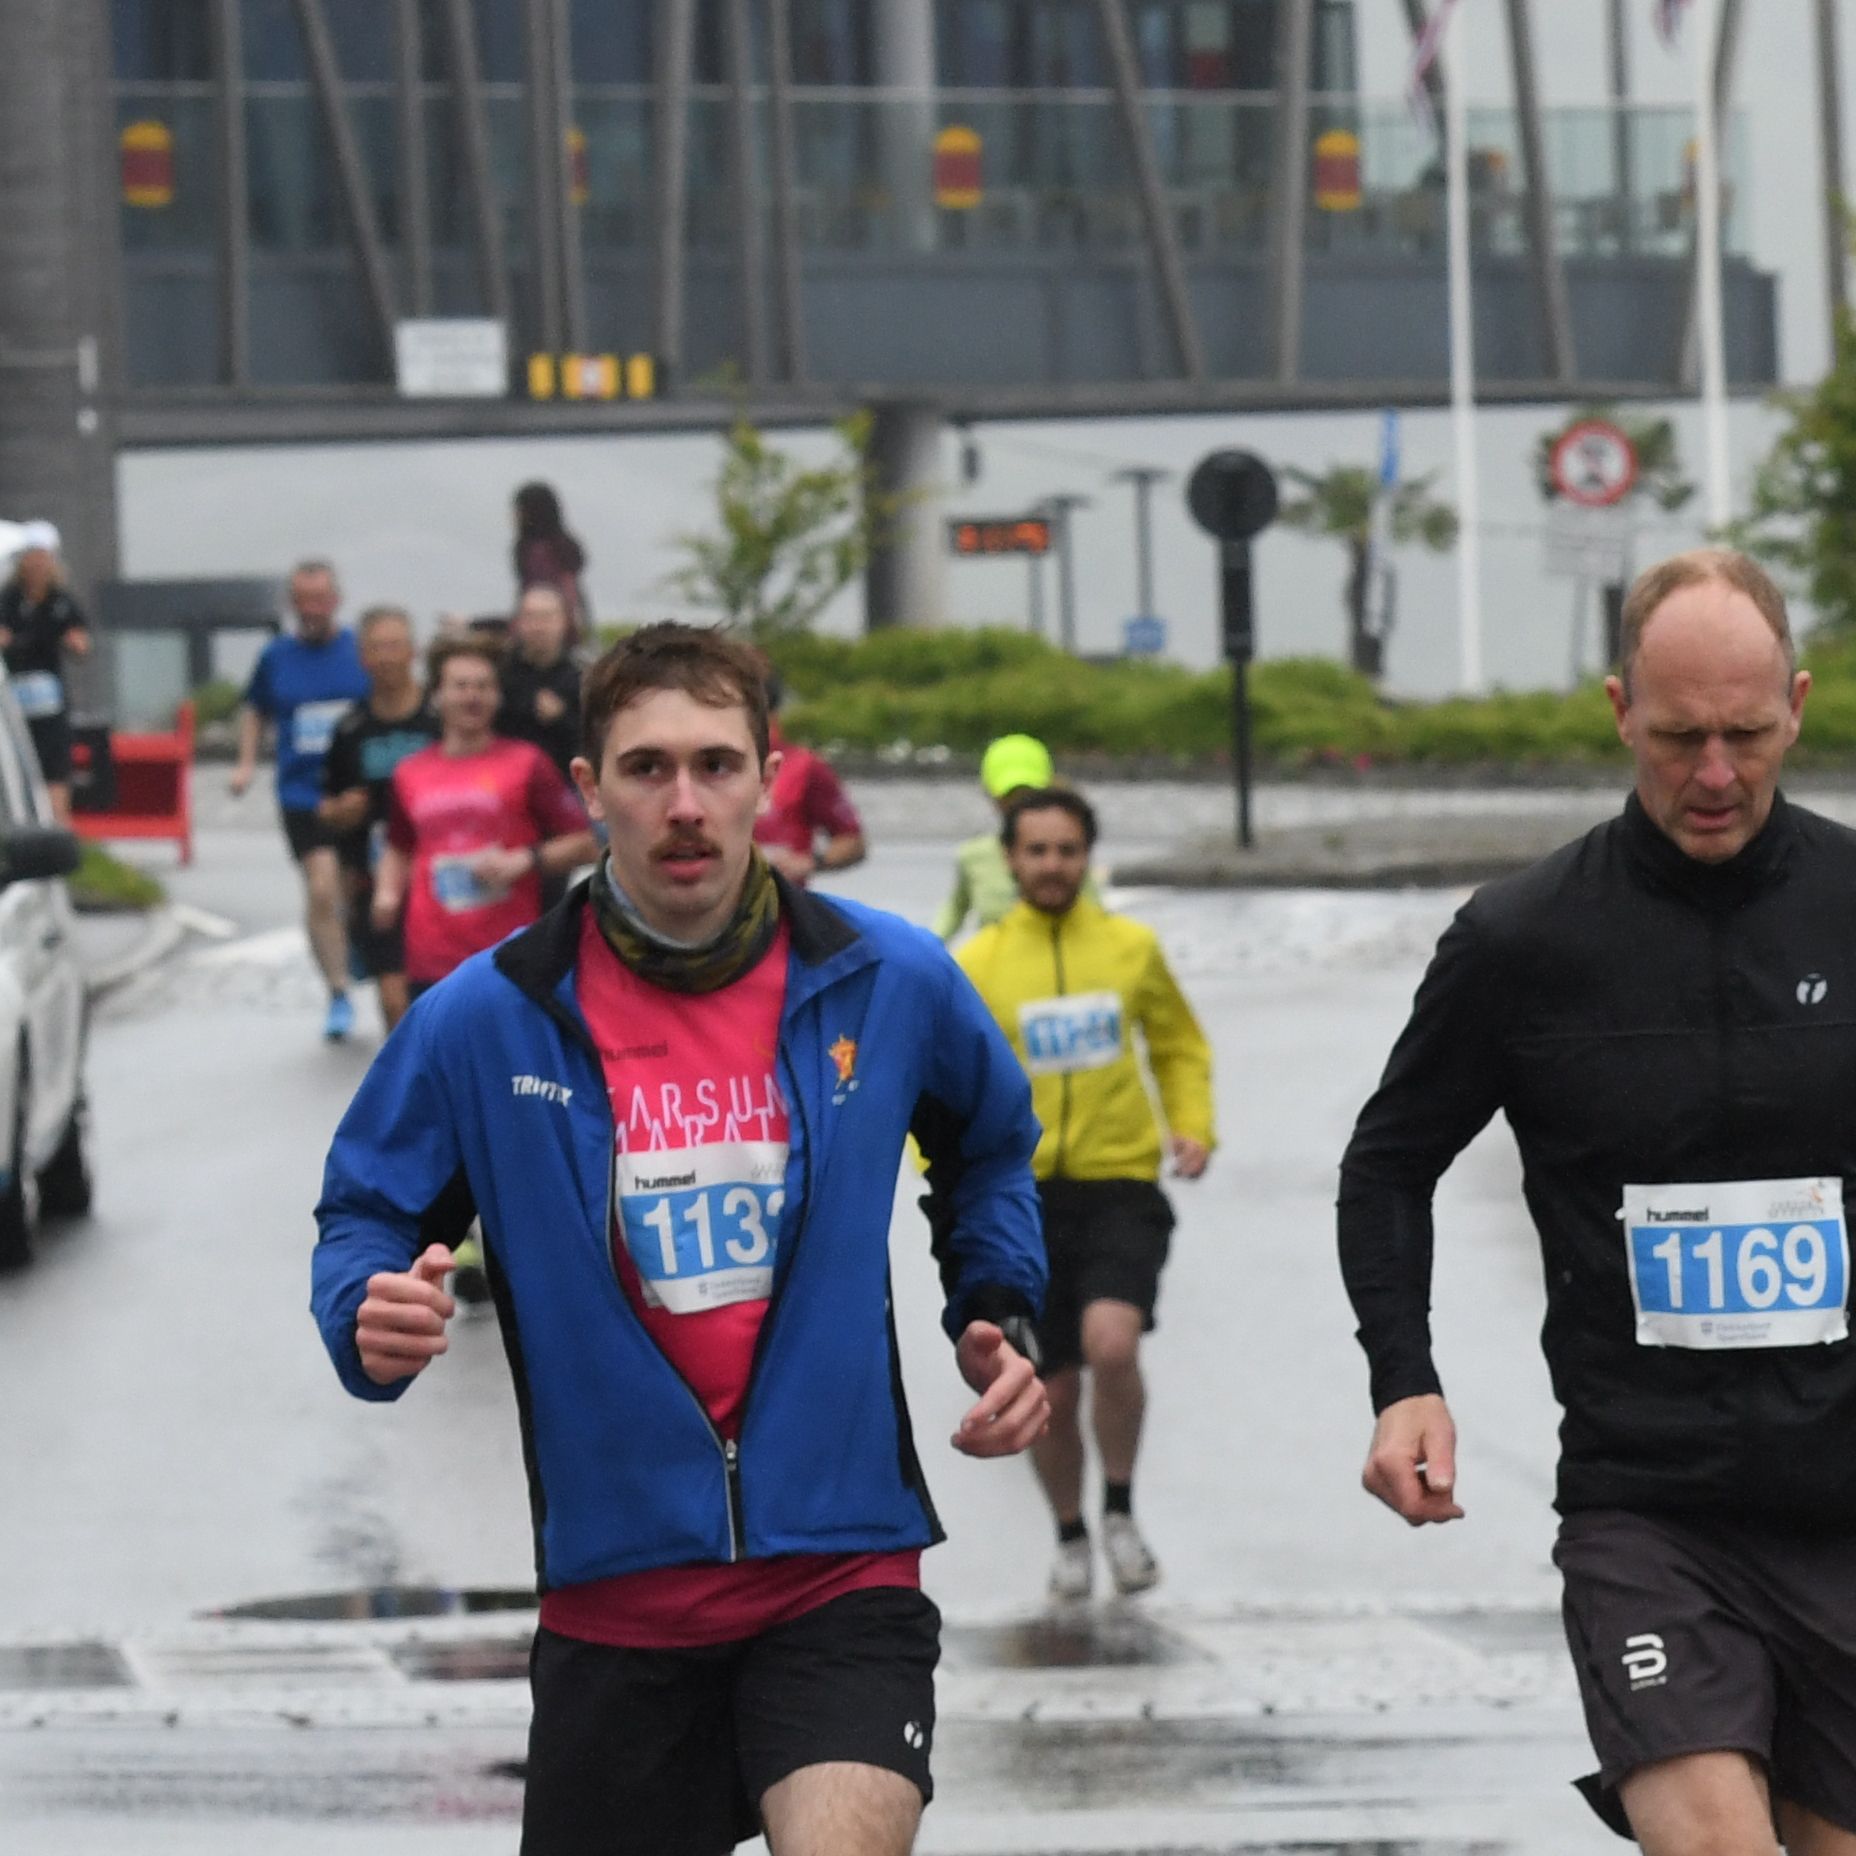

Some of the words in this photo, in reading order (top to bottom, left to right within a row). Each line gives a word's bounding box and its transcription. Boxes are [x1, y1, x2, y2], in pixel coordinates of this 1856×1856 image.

[606, 1073, 789, 1133] ARSUN
[634, 1169, 697, 1190] hummel
[642, 1186, 786, 1276] 113
[1646, 1206, 1710, 1222] hummel
[1652, 1224, 1828, 1310] 1169
